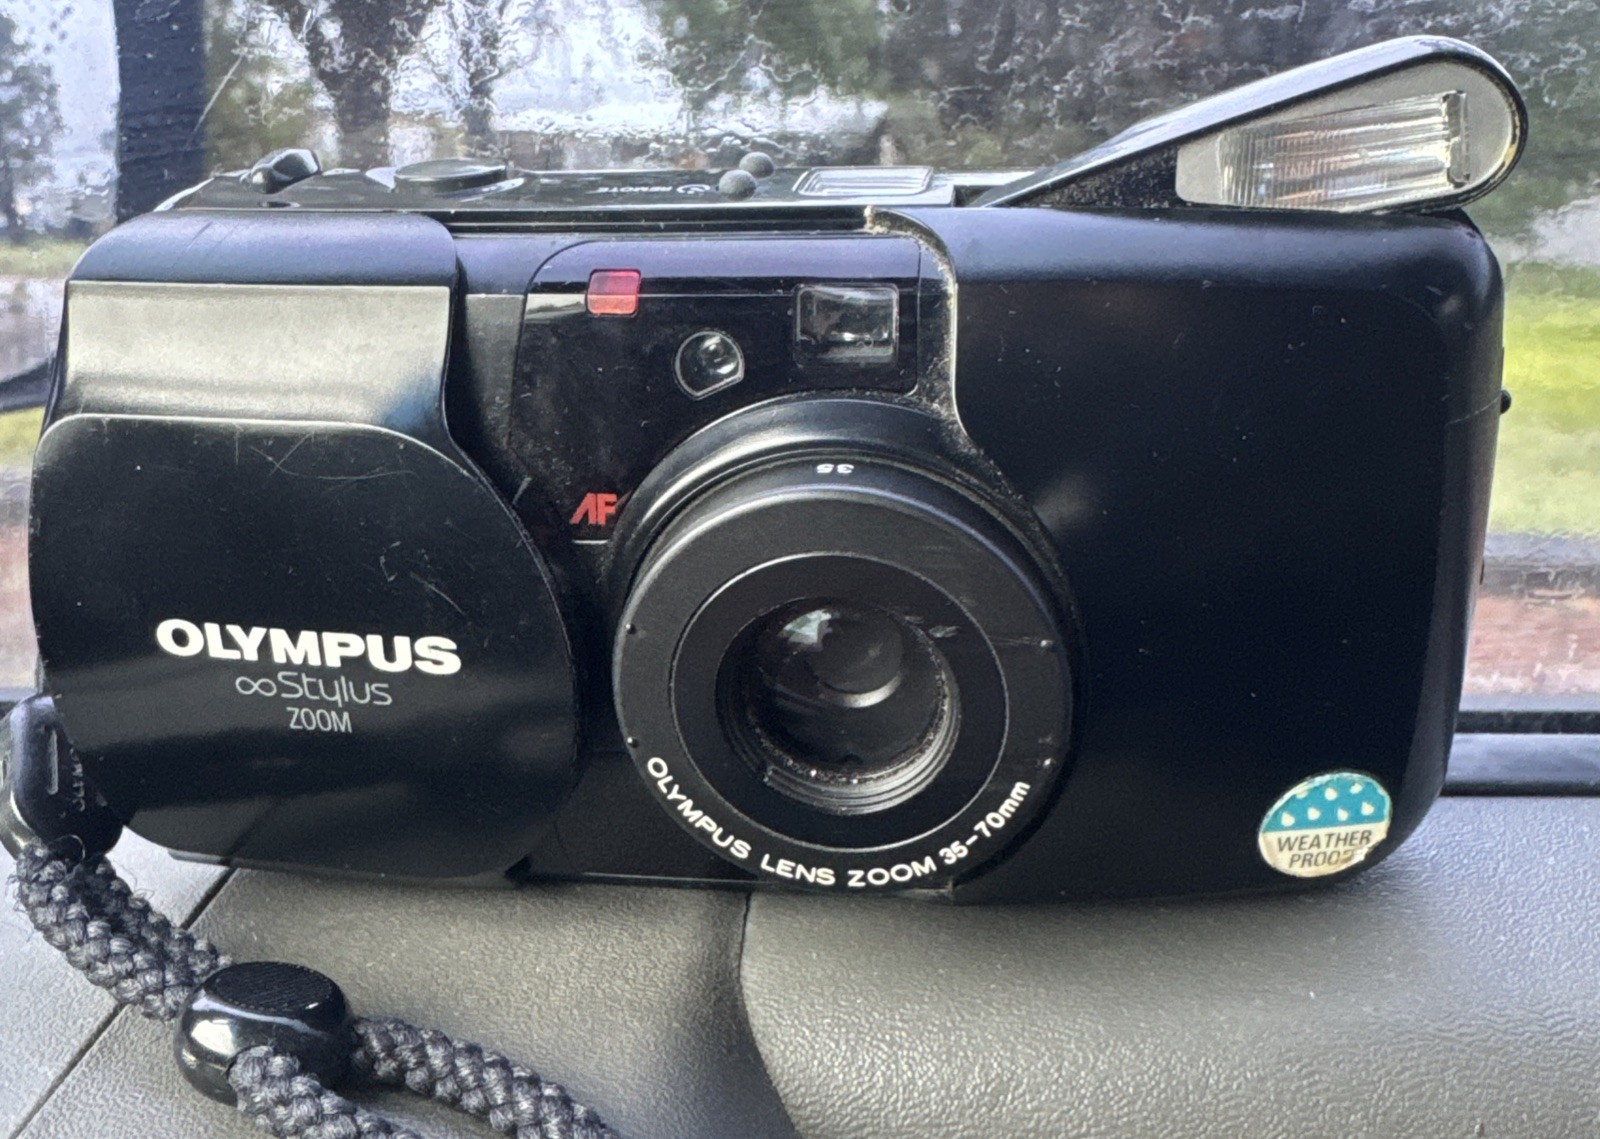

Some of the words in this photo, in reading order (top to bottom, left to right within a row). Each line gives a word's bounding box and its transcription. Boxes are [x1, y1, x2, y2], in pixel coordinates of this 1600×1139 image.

[816, 463, 855, 474] 35
[569, 492, 618, 526] AF
[156, 618, 462, 675] OLYMPUS
[286, 706, 352, 733] ZOOM
[647, 756, 752, 859] OLYMPUS
[760, 853, 836, 886] LENS
[847, 855, 938, 888] ZOOM
[938, 780, 1032, 865] 35-70mm
[1276, 829, 1373, 853] WEATHER
